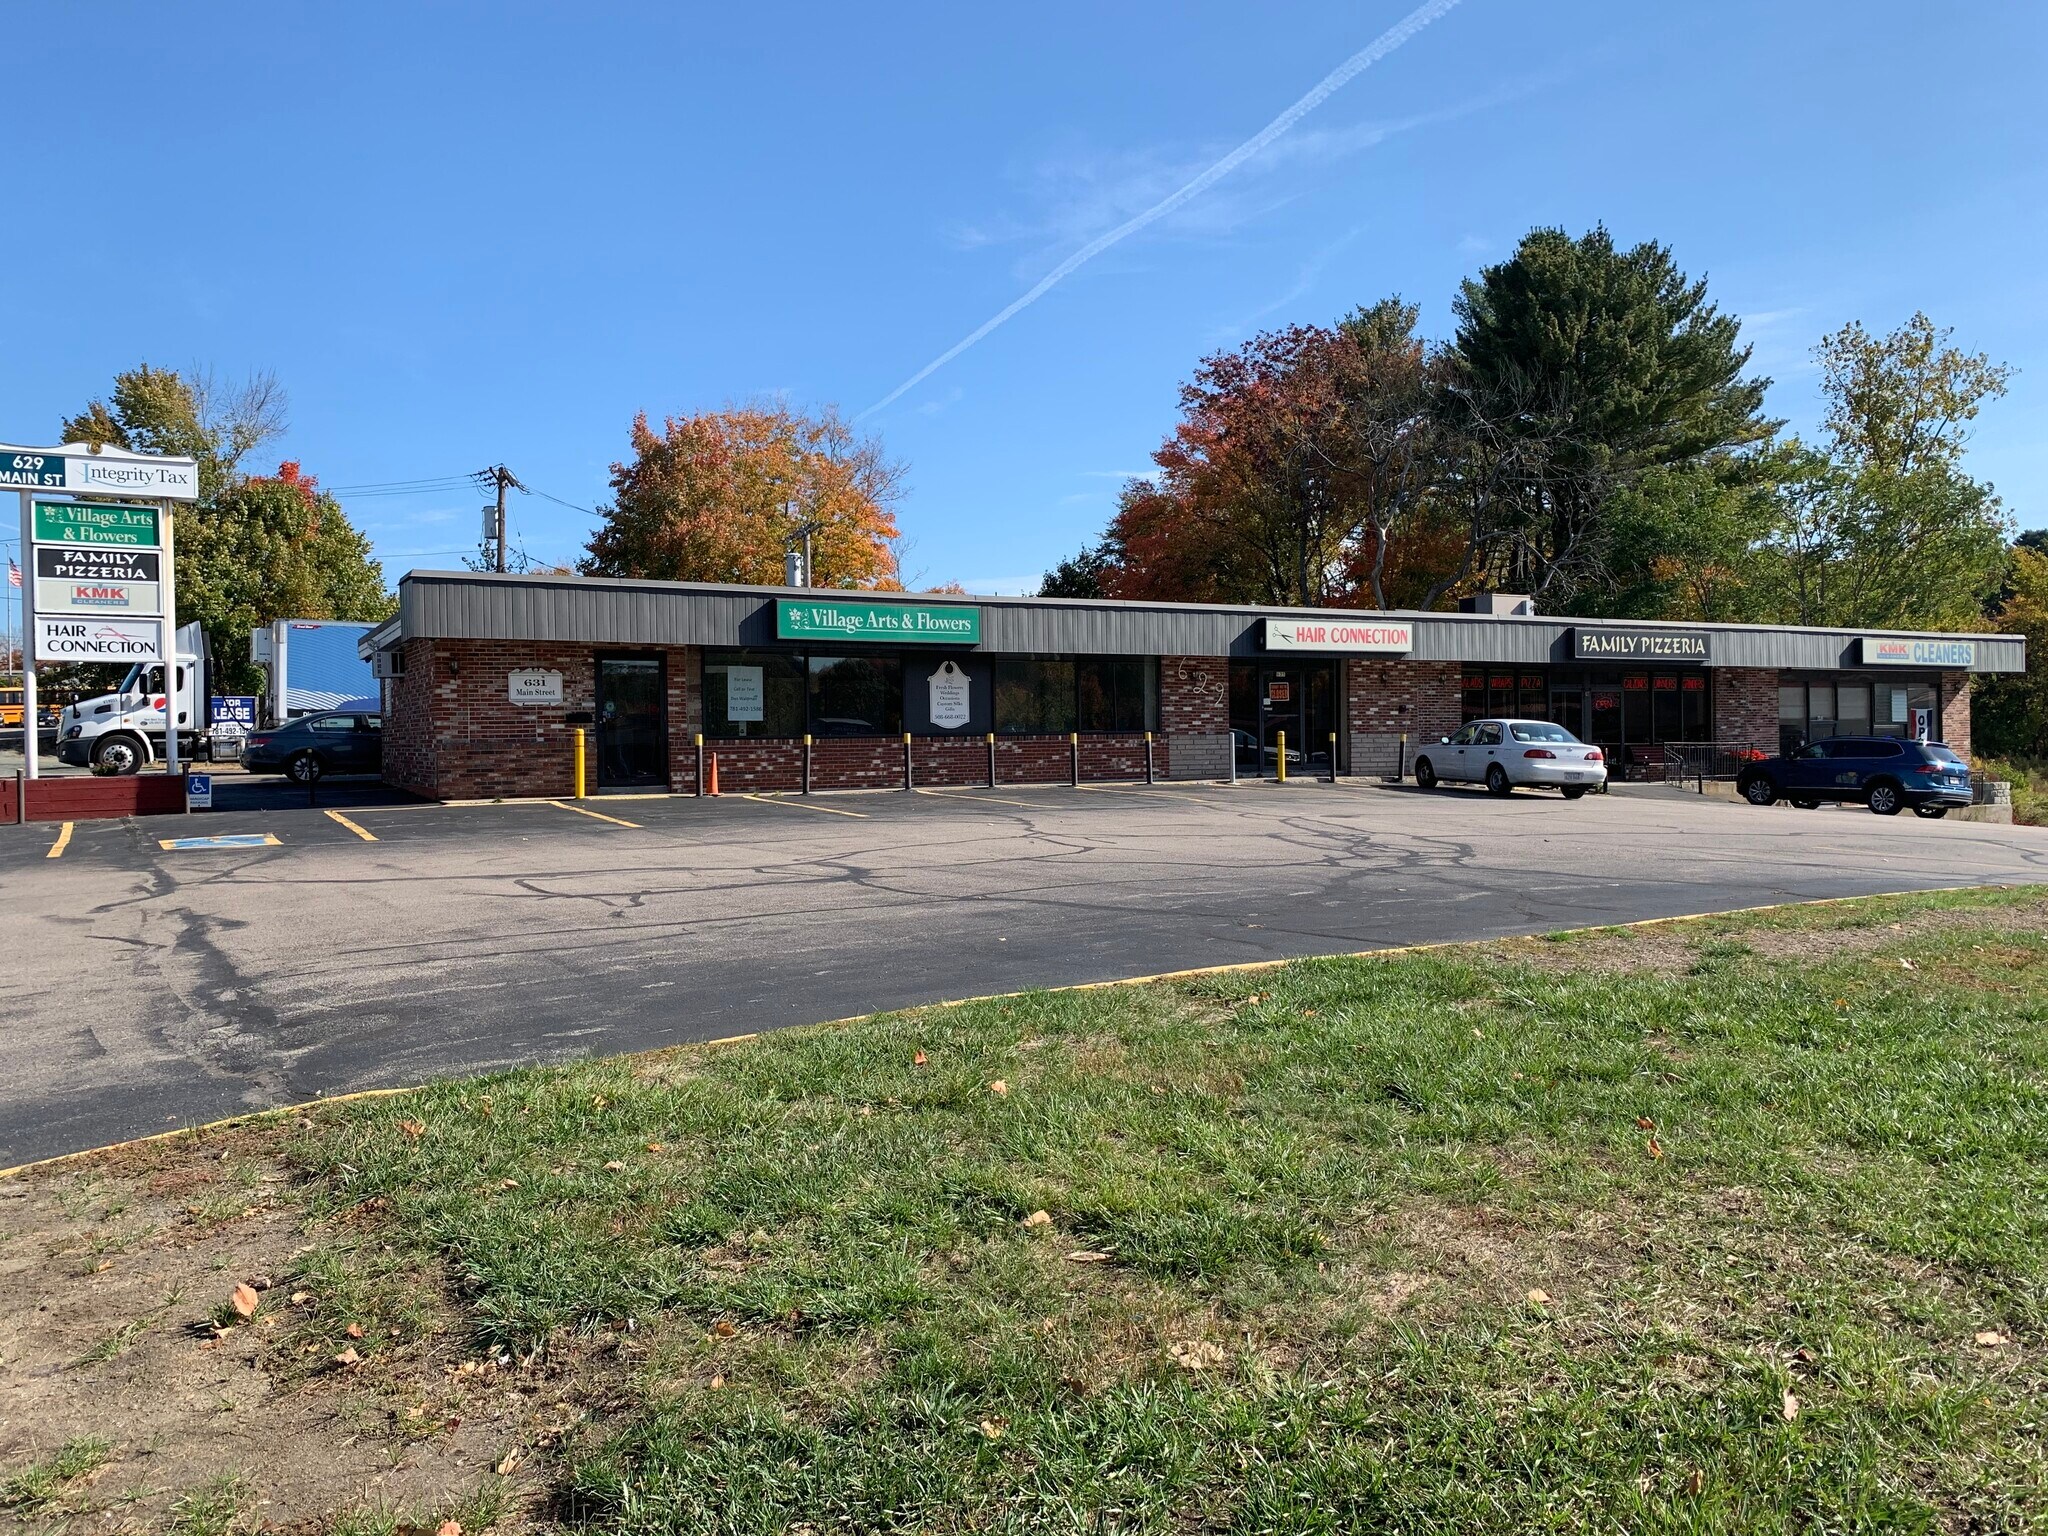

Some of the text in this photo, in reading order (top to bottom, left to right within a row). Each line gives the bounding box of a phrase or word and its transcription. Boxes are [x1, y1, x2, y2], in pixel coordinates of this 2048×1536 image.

[13, 455, 44, 470] 629
[0, 470, 63, 486] MAIN ST
[82, 462, 188, 485] Integrity Tax
[66, 507, 153, 527] Village Arts
[63, 526, 138, 543] & Flowers
[62, 551, 139, 565] FAMILY
[54, 564, 148, 580] PIZZERIA
[76, 586, 125, 599] KMK
[811, 608, 971, 634] Village Arts & Flowers
[47, 624, 86, 637] HAIR
[1296, 626, 1408, 644] HAIR CONNECTION
[47, 640, 156, 654] CONNECTION
[1582, 635, 1706, 654] FAMILY PIZZERIA
[1880, 643, 1907, 654] KMK
[1913, 642, 1972, 664] CLEANERS
[524, 679, 547, 687] 631
[1178, 656, 1225, 706] 629
[1461, 676, 1484, 688] ALADS
[1490, 677, 1513, 688] WRAPS
[1521, 677, 1541, 688] PIZZA
[516, 688, 555, 696] Main Street
[223, 699, 241, 707] FOR
[213, 707, 250, 720] LEASE
